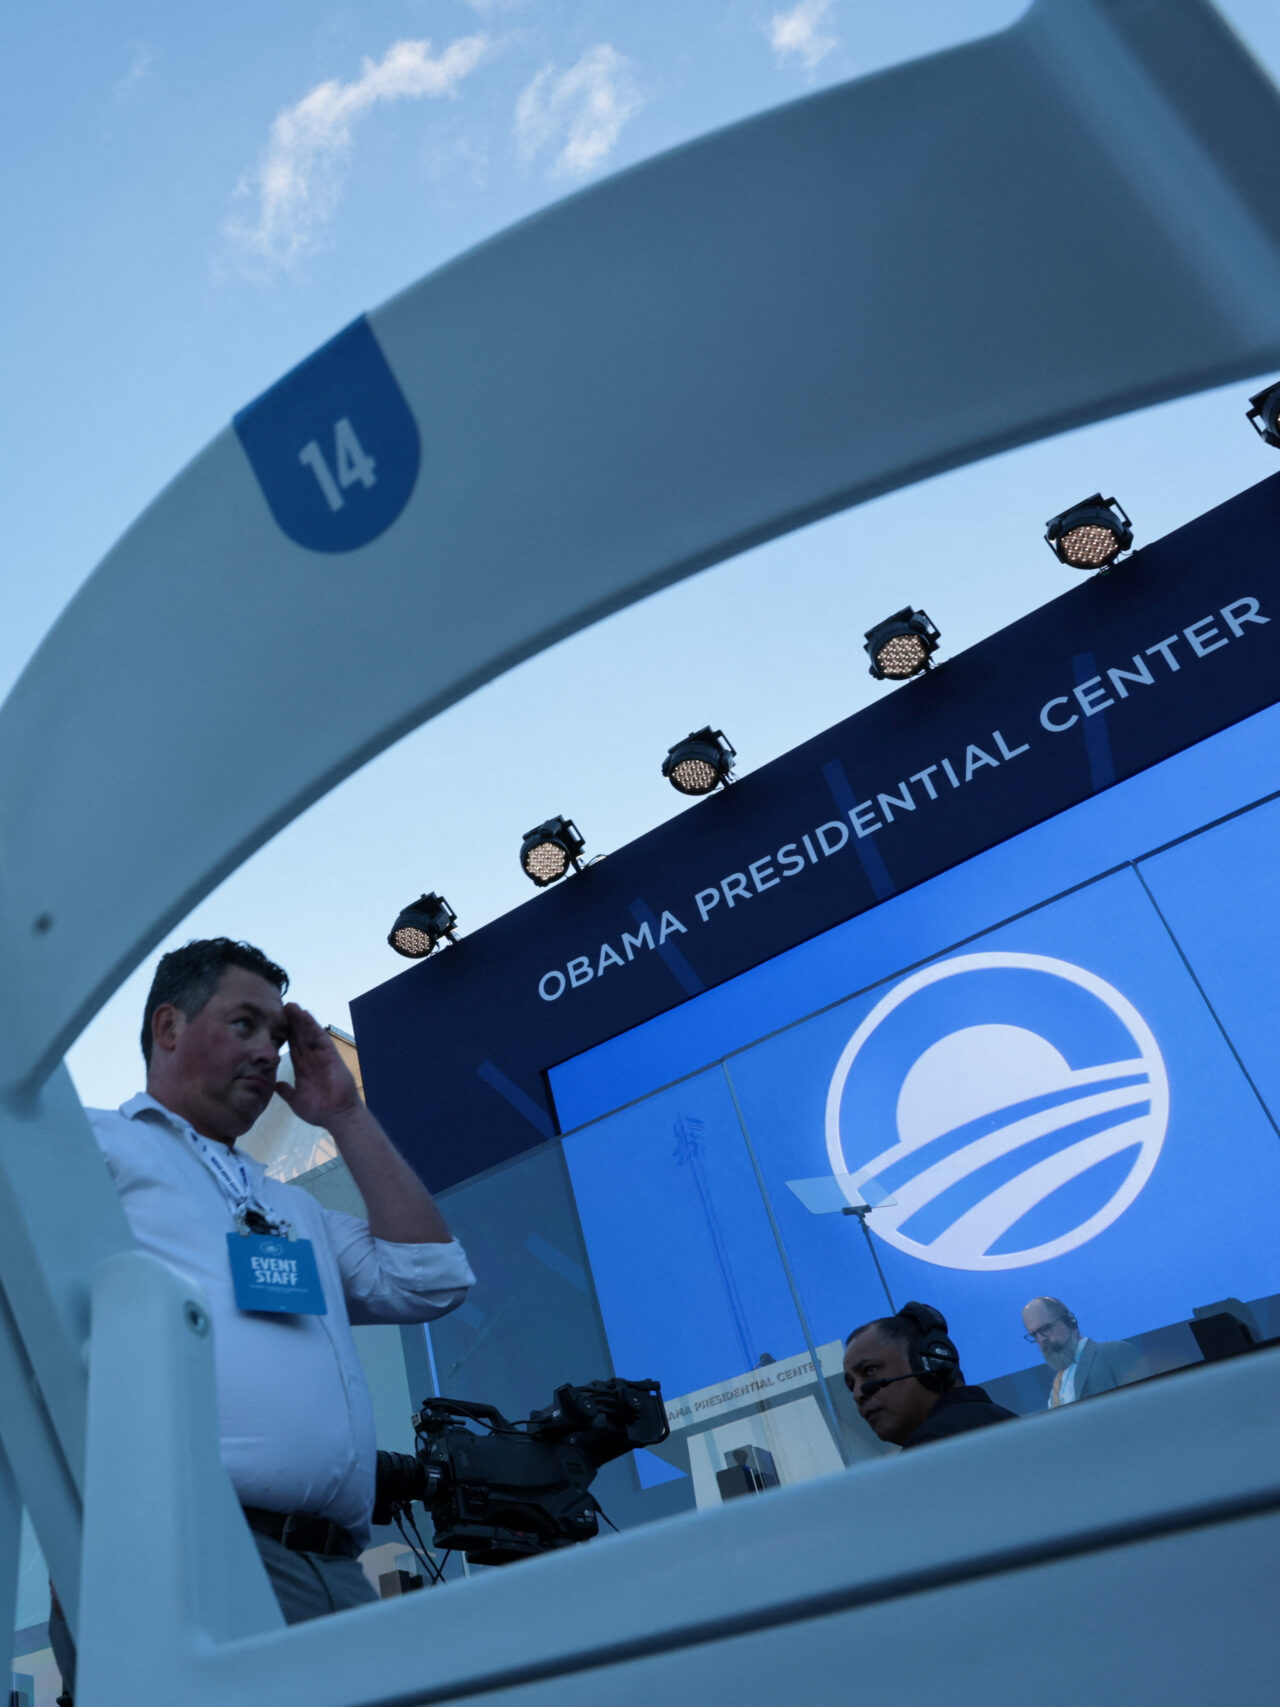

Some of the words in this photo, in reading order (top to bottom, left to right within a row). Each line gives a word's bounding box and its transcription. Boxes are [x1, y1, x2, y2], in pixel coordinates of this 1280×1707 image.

[298, 417, 377, 513] 14
[538, 909, 688, 1001] OBAMA
[694, 730, 1030, 922] PRESIDENTIAL
[1039, 596, 1270, 734] CENTER
[250, 1256, 297, 1273] EVENT
[255, 1270, 298, 1286] STAFF
[667, 1405, 693, 1421] AMA
[694, 1377, 776, 1412] PRESIDENTIAL
